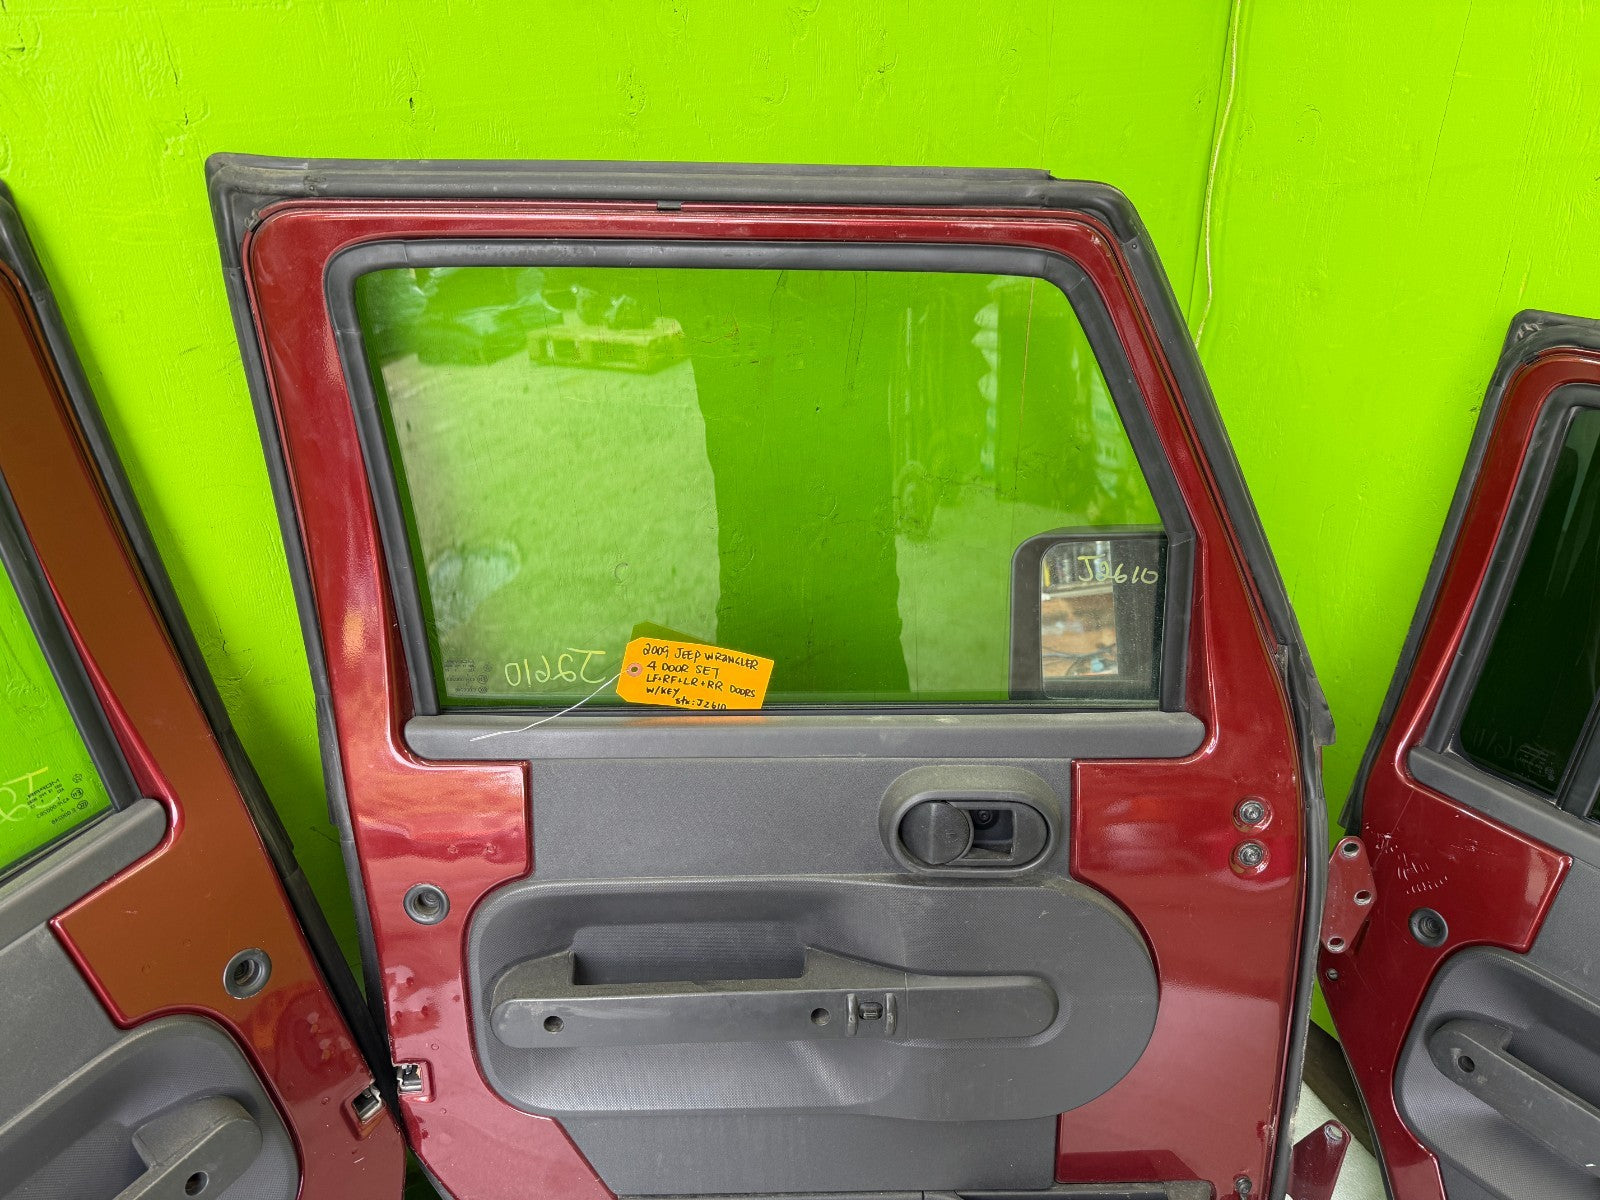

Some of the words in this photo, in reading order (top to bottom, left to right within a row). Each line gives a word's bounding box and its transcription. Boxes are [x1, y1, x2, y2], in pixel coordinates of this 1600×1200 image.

[1077, 553, 1158, 584] J2610
[643, 642, 669, 659] 2009
[674, 647, 701, 663] JEEP
[704, 652, 759, 671] WRANGLER
[646, 660, 657, 672] 4
[661, 662, 689, 673] DOOR
[695, 665, 720, 679] SET
[646, 686, 681, 699] W/KEY
[729, 684, 756, 698] DOORS
